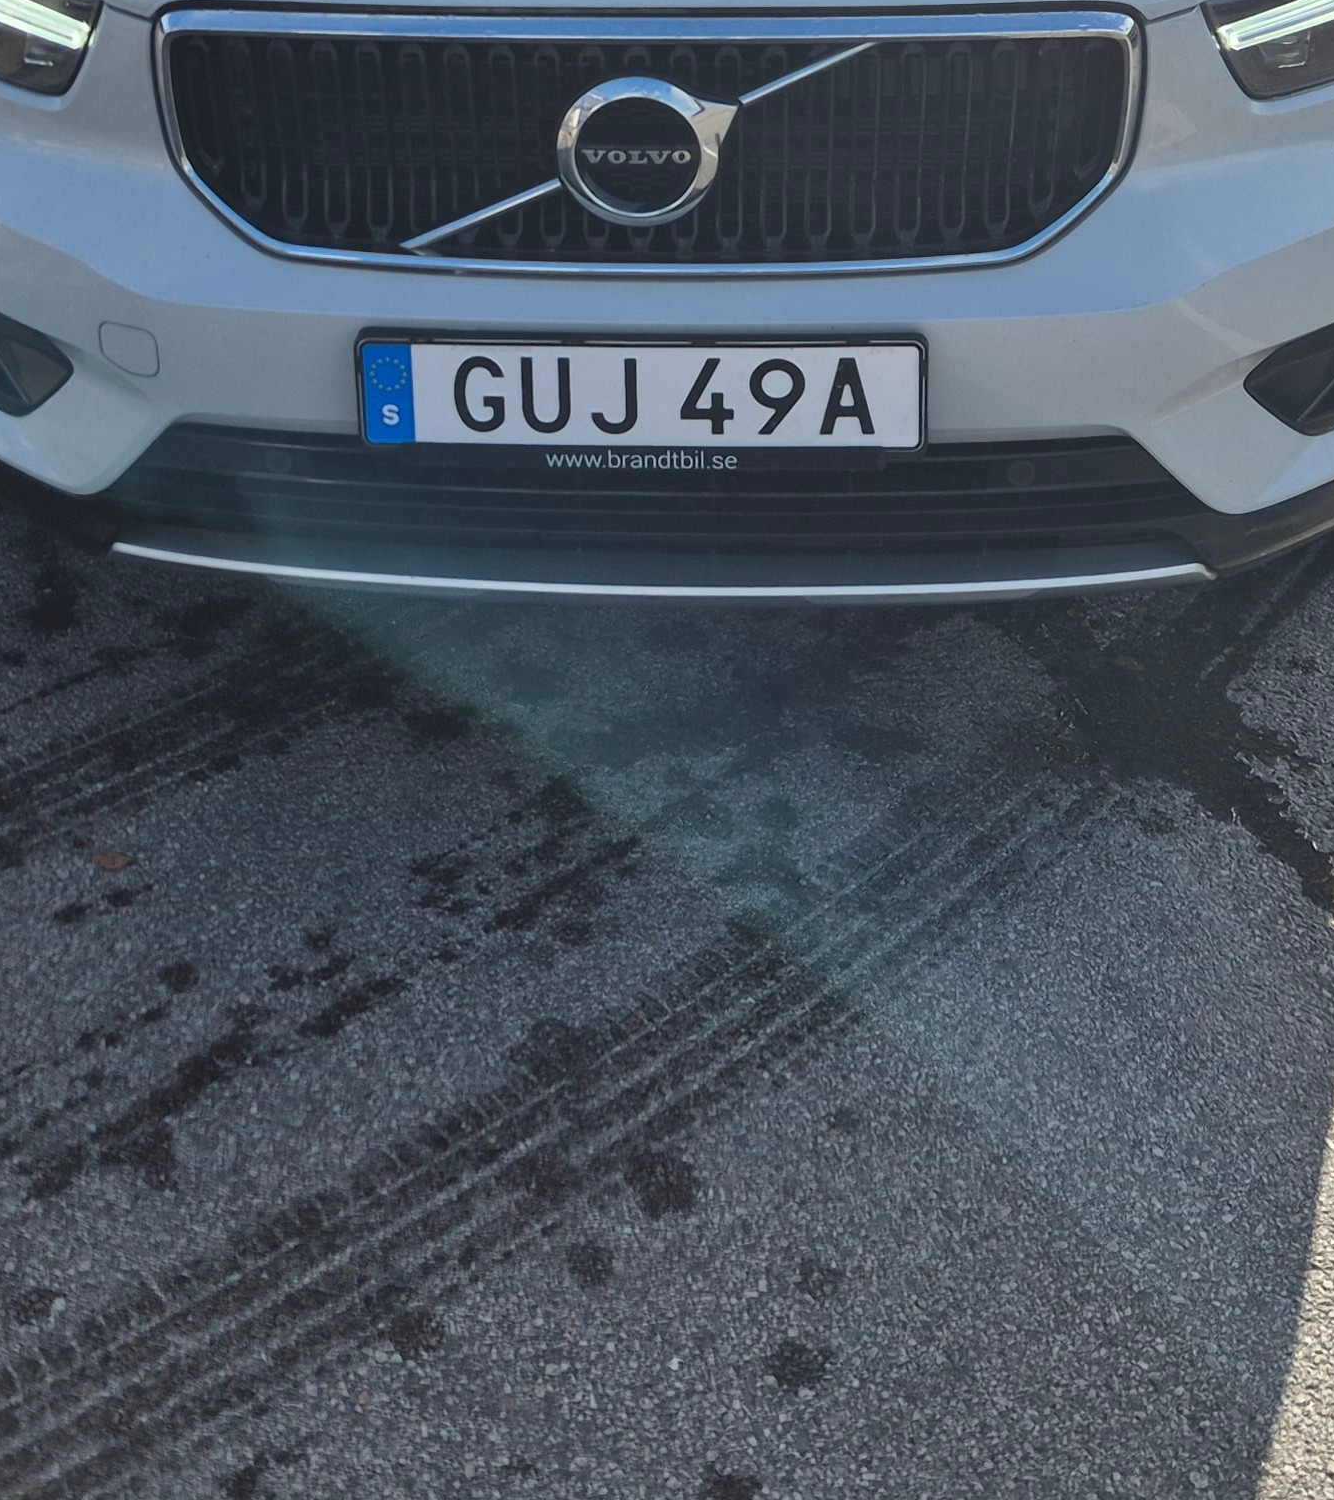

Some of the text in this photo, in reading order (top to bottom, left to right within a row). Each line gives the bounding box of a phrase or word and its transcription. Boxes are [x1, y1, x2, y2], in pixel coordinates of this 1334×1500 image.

[581, 149, 692, 165] VOLVO
[454, 356, 875, 435] GUJ 49A
[381, 404, 400, 426] S
[546, 449, 738, 470] www.brandtbil.se
